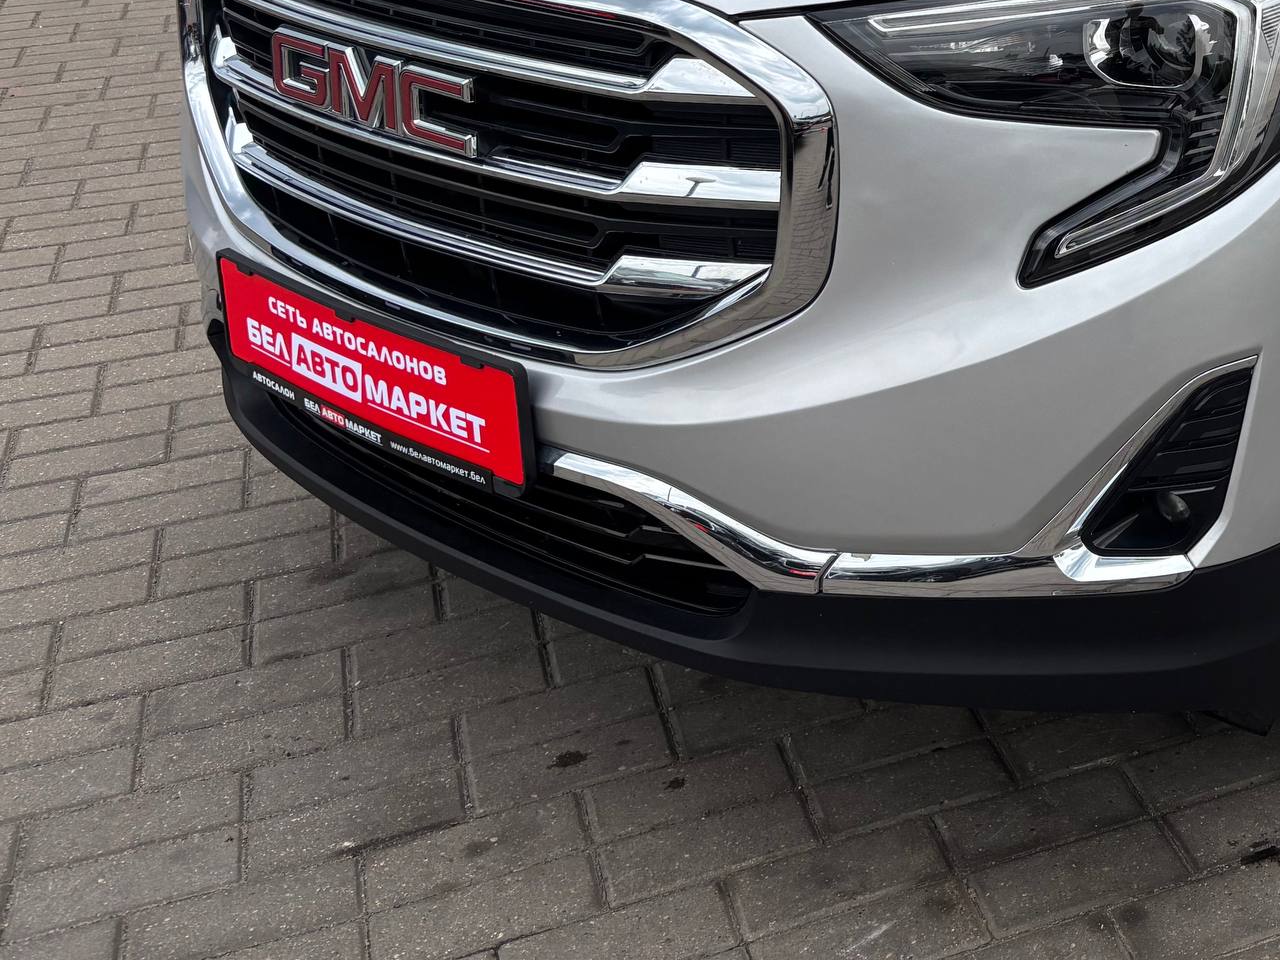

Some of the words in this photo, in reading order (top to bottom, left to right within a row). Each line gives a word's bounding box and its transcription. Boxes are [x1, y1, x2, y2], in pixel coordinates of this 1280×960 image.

[272, 25, 478, 158] GMC
[268, 296, 307, 329] СЕТЬ
[312, 318, 447, 386] АВТОСАЛОНОВ
[252, 371, 295, 400] АВТОСАЛОН
[389, 441, 486, 484] www.белавтомаркет.бел
